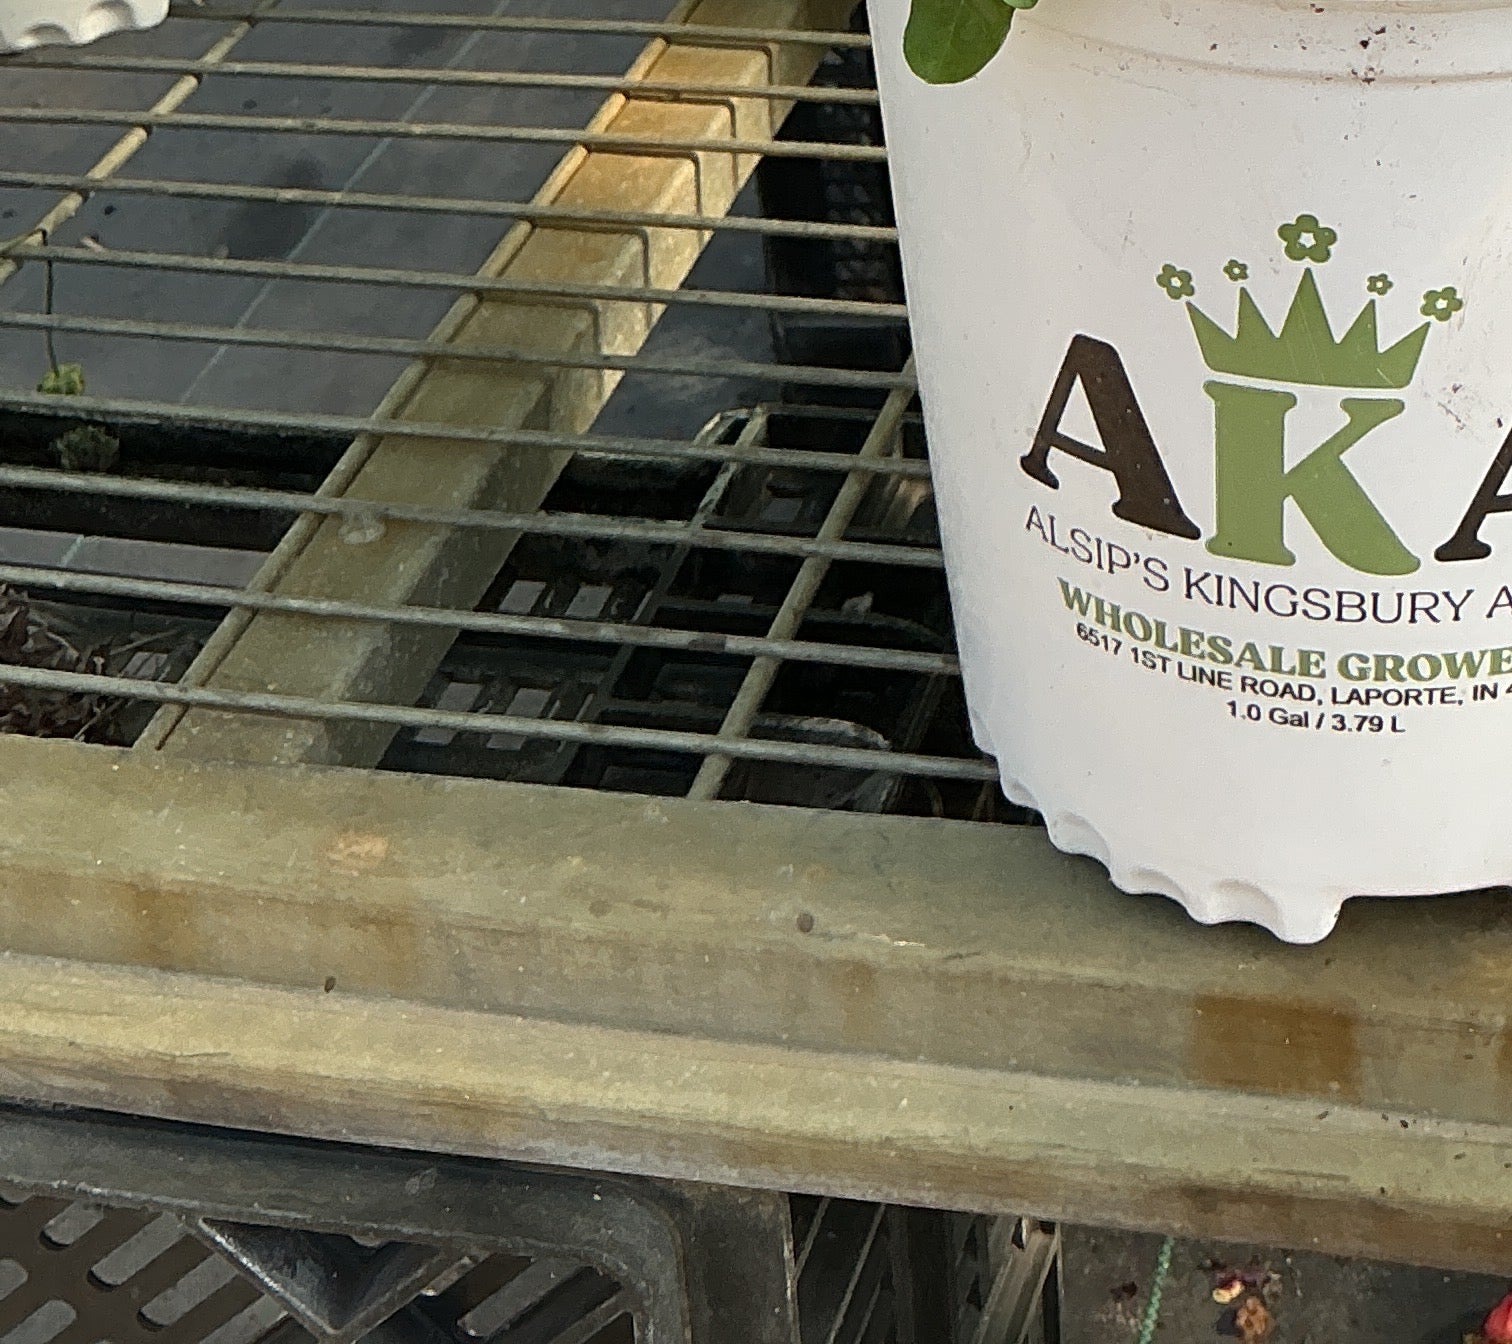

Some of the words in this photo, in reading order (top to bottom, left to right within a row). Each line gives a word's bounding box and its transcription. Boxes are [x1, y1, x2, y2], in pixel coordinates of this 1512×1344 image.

[1025, 505, 1170, 592] ALSIP'S
[1184, 567, 1475, 624] KINGSBURY
[1056, 576, 1327, 680] WHOLESALE
[1075, 621, 1122, 656] 6517
[1131, 647, 1172, 675] 1ST
[1177, 660, 1234, 691] LINE
[1240, 675, 1324, 707] ROAD,
[1331, 686, 1464, 707] LAPORTE,
[1472, 682, 1498, 702] IN
[1226, 699, 1262, 722] 1.0
[1268, 707, 1310, 729] Gal
[1315, 712, 1326, 731] /
[1331, 713, 1384, 734] 3.79
[1391, 715, 1406, 734] L
